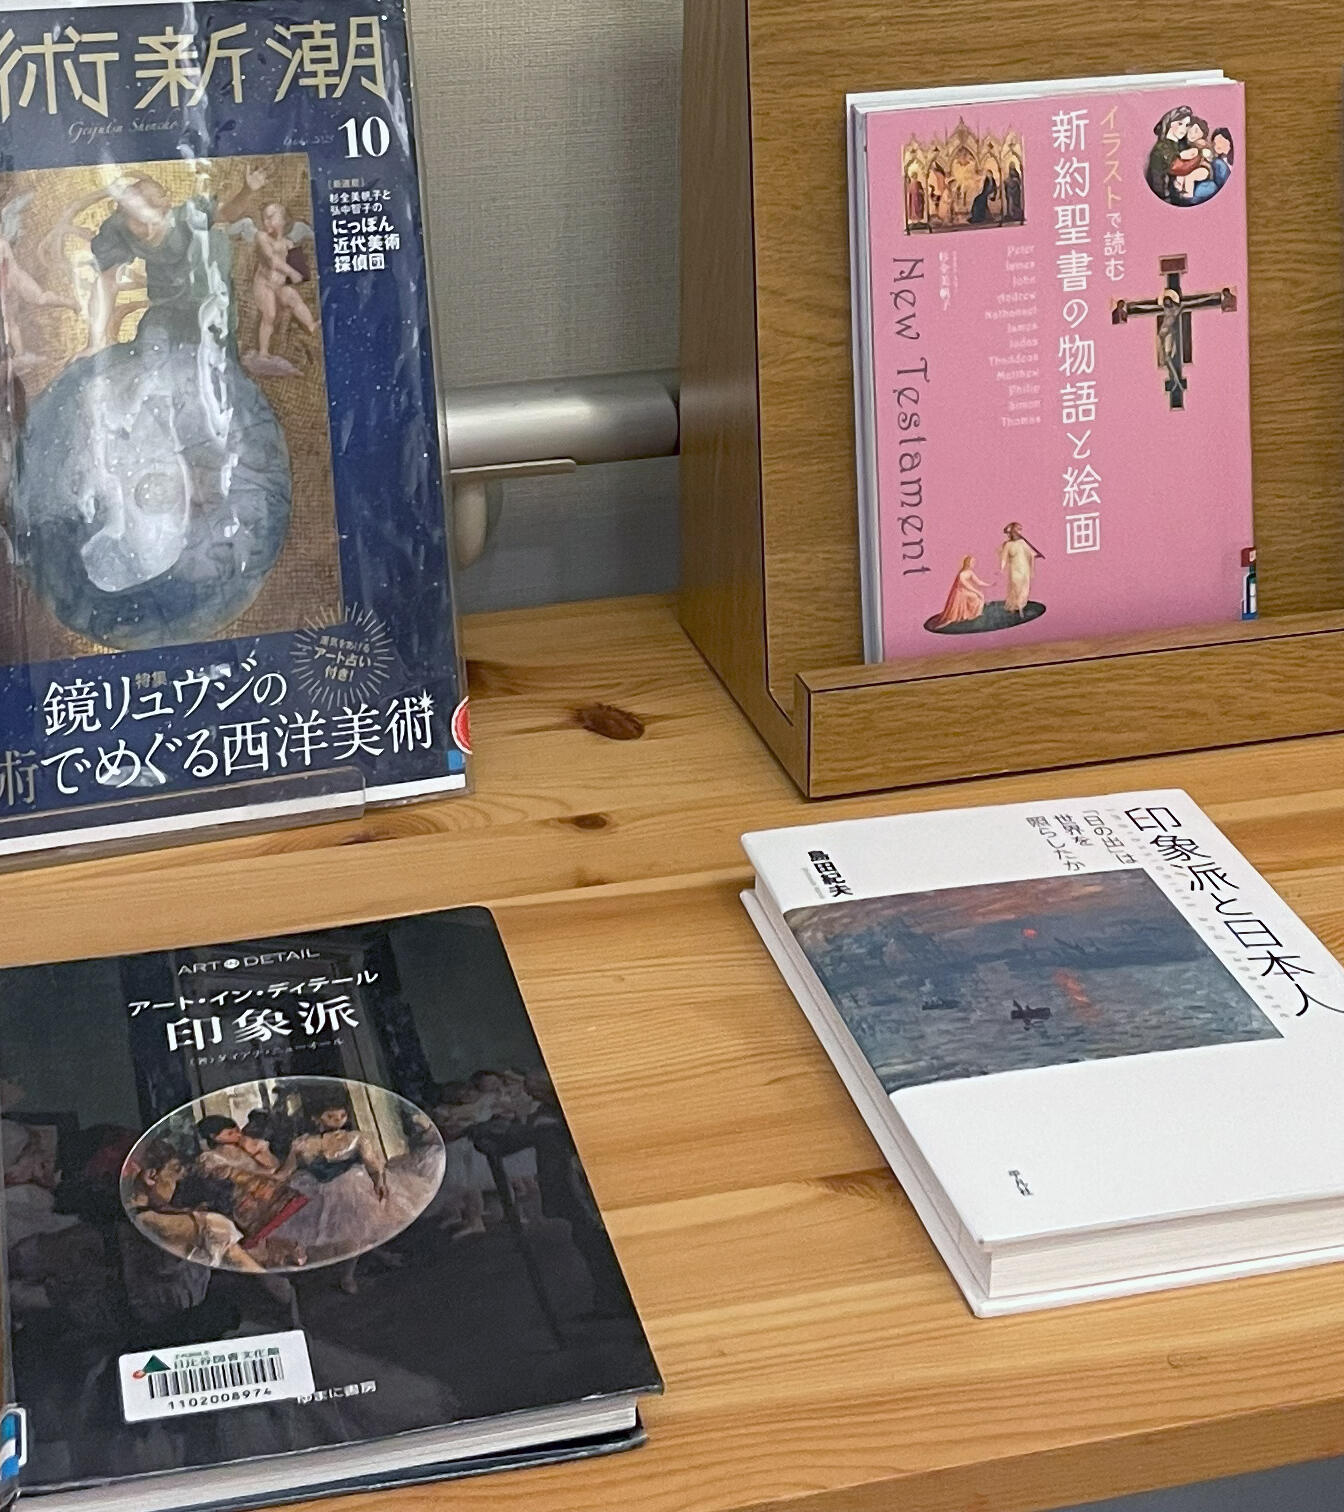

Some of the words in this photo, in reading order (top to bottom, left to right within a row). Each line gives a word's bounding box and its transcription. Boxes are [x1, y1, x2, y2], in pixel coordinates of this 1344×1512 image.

[337, 116, 391, 159] 10
[329, 189, 391, 204] 杉全美帆子と
[1099, 105, 1126, 283] イラストで読む
[332, 215, 395, 235] にっぽん
[333, 233, 400, 255] 近代美術
[335, 255, 385, 273] 探偵団
[892, 255, 925, 341] New
[1051, 109, 1102, 555] 新約聖書の物語と絵画
[895, 357, 929, 576] Testament
[312, 646, 372, 669] アート占い
[43, 656, 287, 737] 鏡リュウジの
[1026, 815, 1086, 872] 照らしたか
[1053, 814, 1092, 847] 世界を
[1083, 809, 1138, 865] 「日の出」は
[807, 849, 855, 898] 島田紀夫
[178, 960, 221, 976] ART
[244, 948, 321, 967] DETAIL
[128, 970, 379, 1017] アート・イン・ディテール
[166, 995, 360, 1052] 印象派
